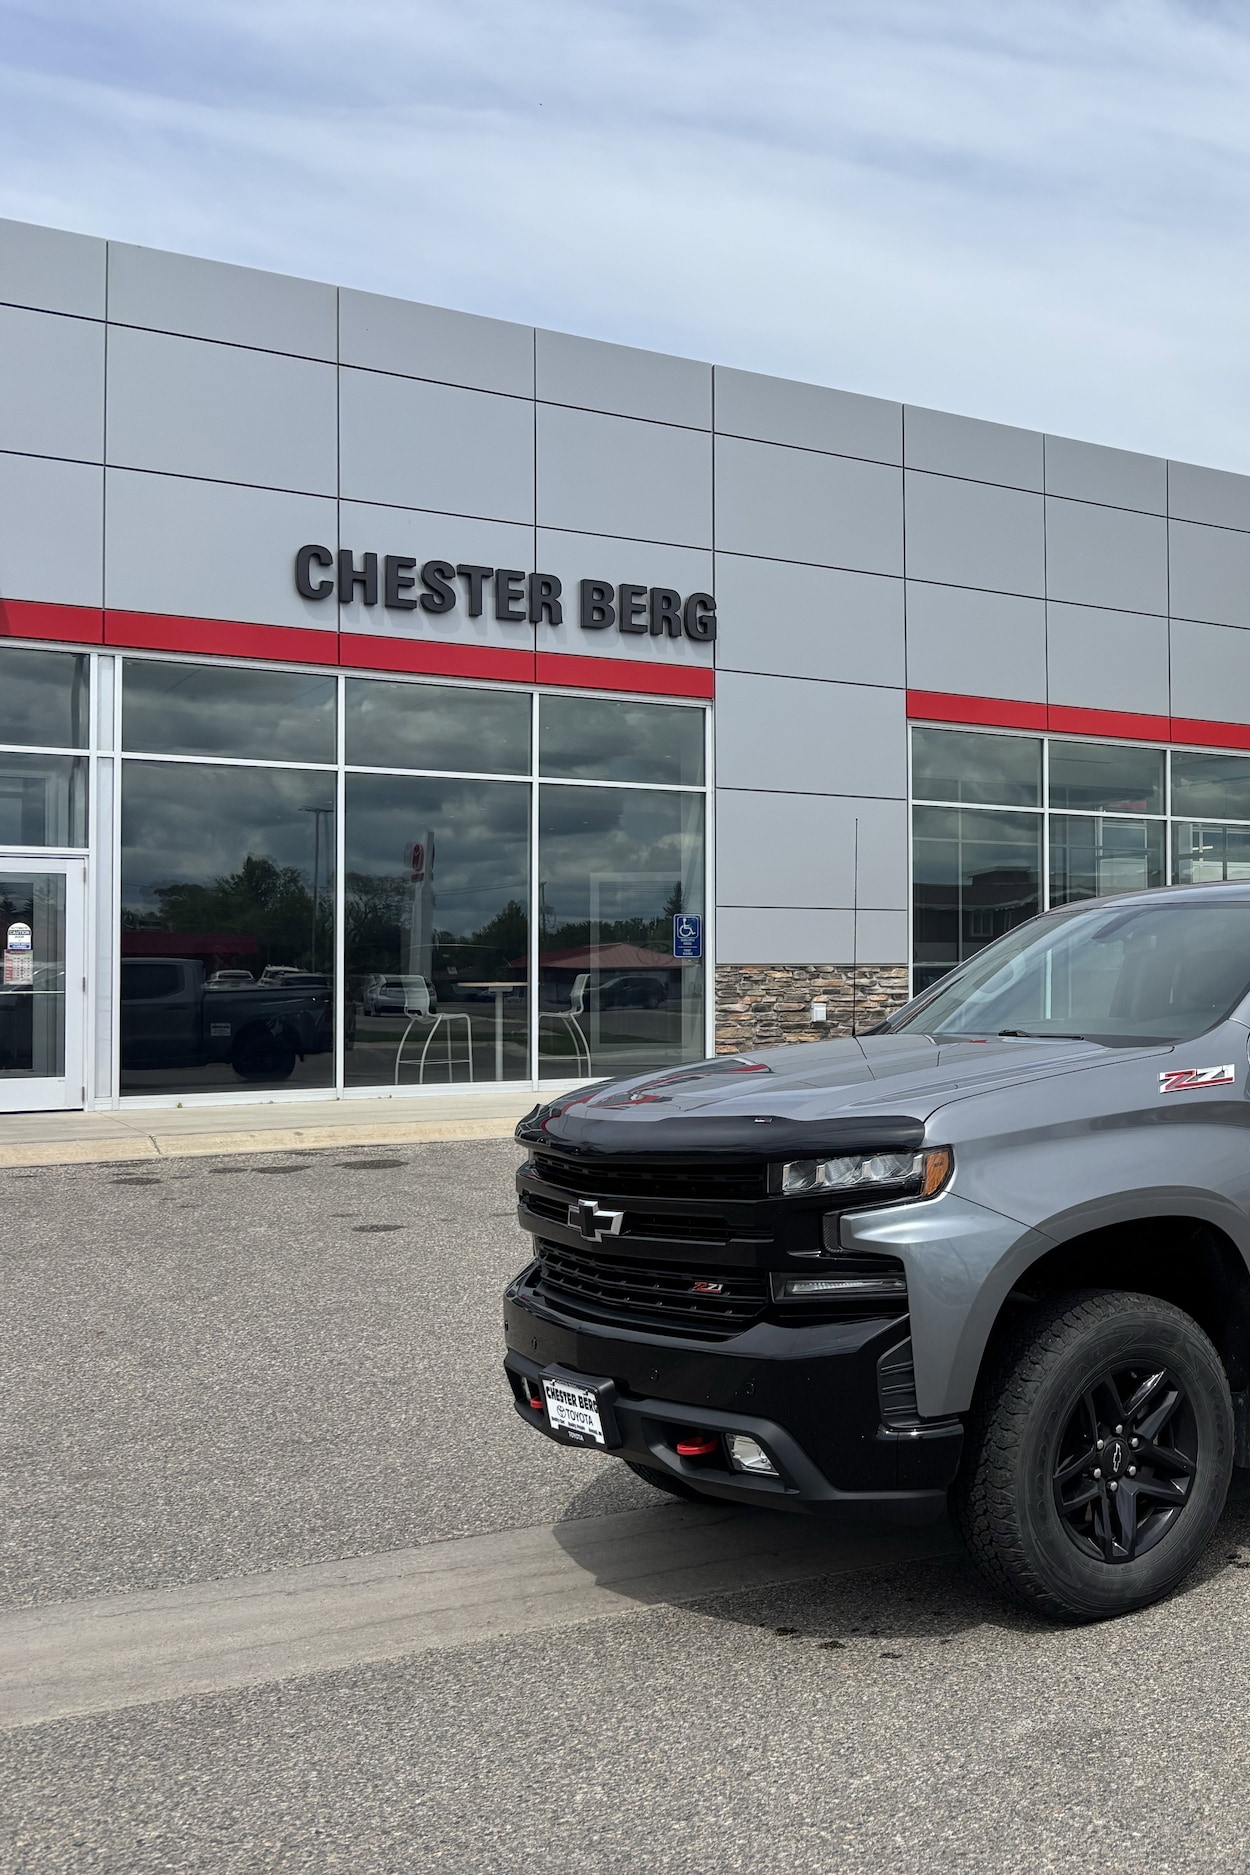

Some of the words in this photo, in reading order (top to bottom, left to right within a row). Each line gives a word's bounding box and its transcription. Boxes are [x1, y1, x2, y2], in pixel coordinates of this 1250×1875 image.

[295, 544, 563, 625] CHESTER
[580, 578, 717, 641] BERG
[1159, 1063, 1235, 1094] Z71
[545, 1386, 578, 1408] CHESTER
[577, 1395, 600, 1414] BERG
[565, 1408, 594, 1426] TOYOTA
